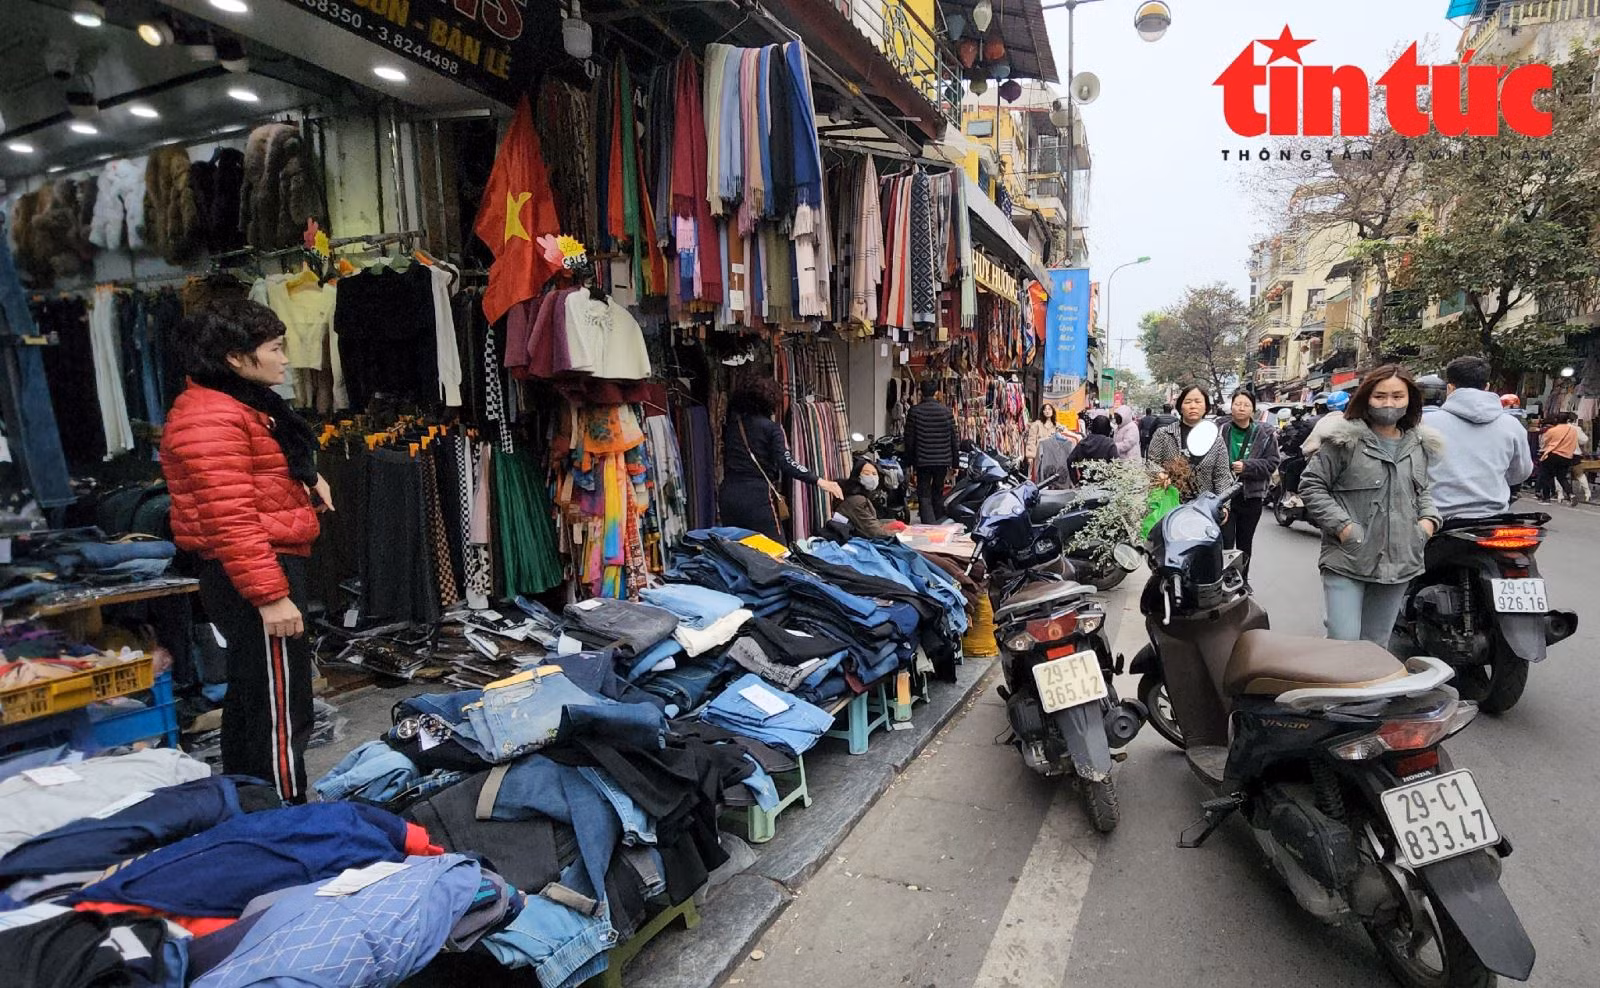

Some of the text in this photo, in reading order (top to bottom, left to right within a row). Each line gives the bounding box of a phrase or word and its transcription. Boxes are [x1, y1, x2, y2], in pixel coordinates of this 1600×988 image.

[378, 26, 459, 75] 3.8244498
[1500, 581, 1537, 595] 29-C1
[1498, 596, 1545, 611] 926.16
[1043, 656, 1089, 686] 29-F1
[1045, 676, 1102, 708] 365.42
[1260, 719, 1310, 731] VISION
[1402, 770, 1433, 783] HONDA
[1397, 778, 1469, 825] 29-C1
[1404, 809, 1488, 861] 833.47
